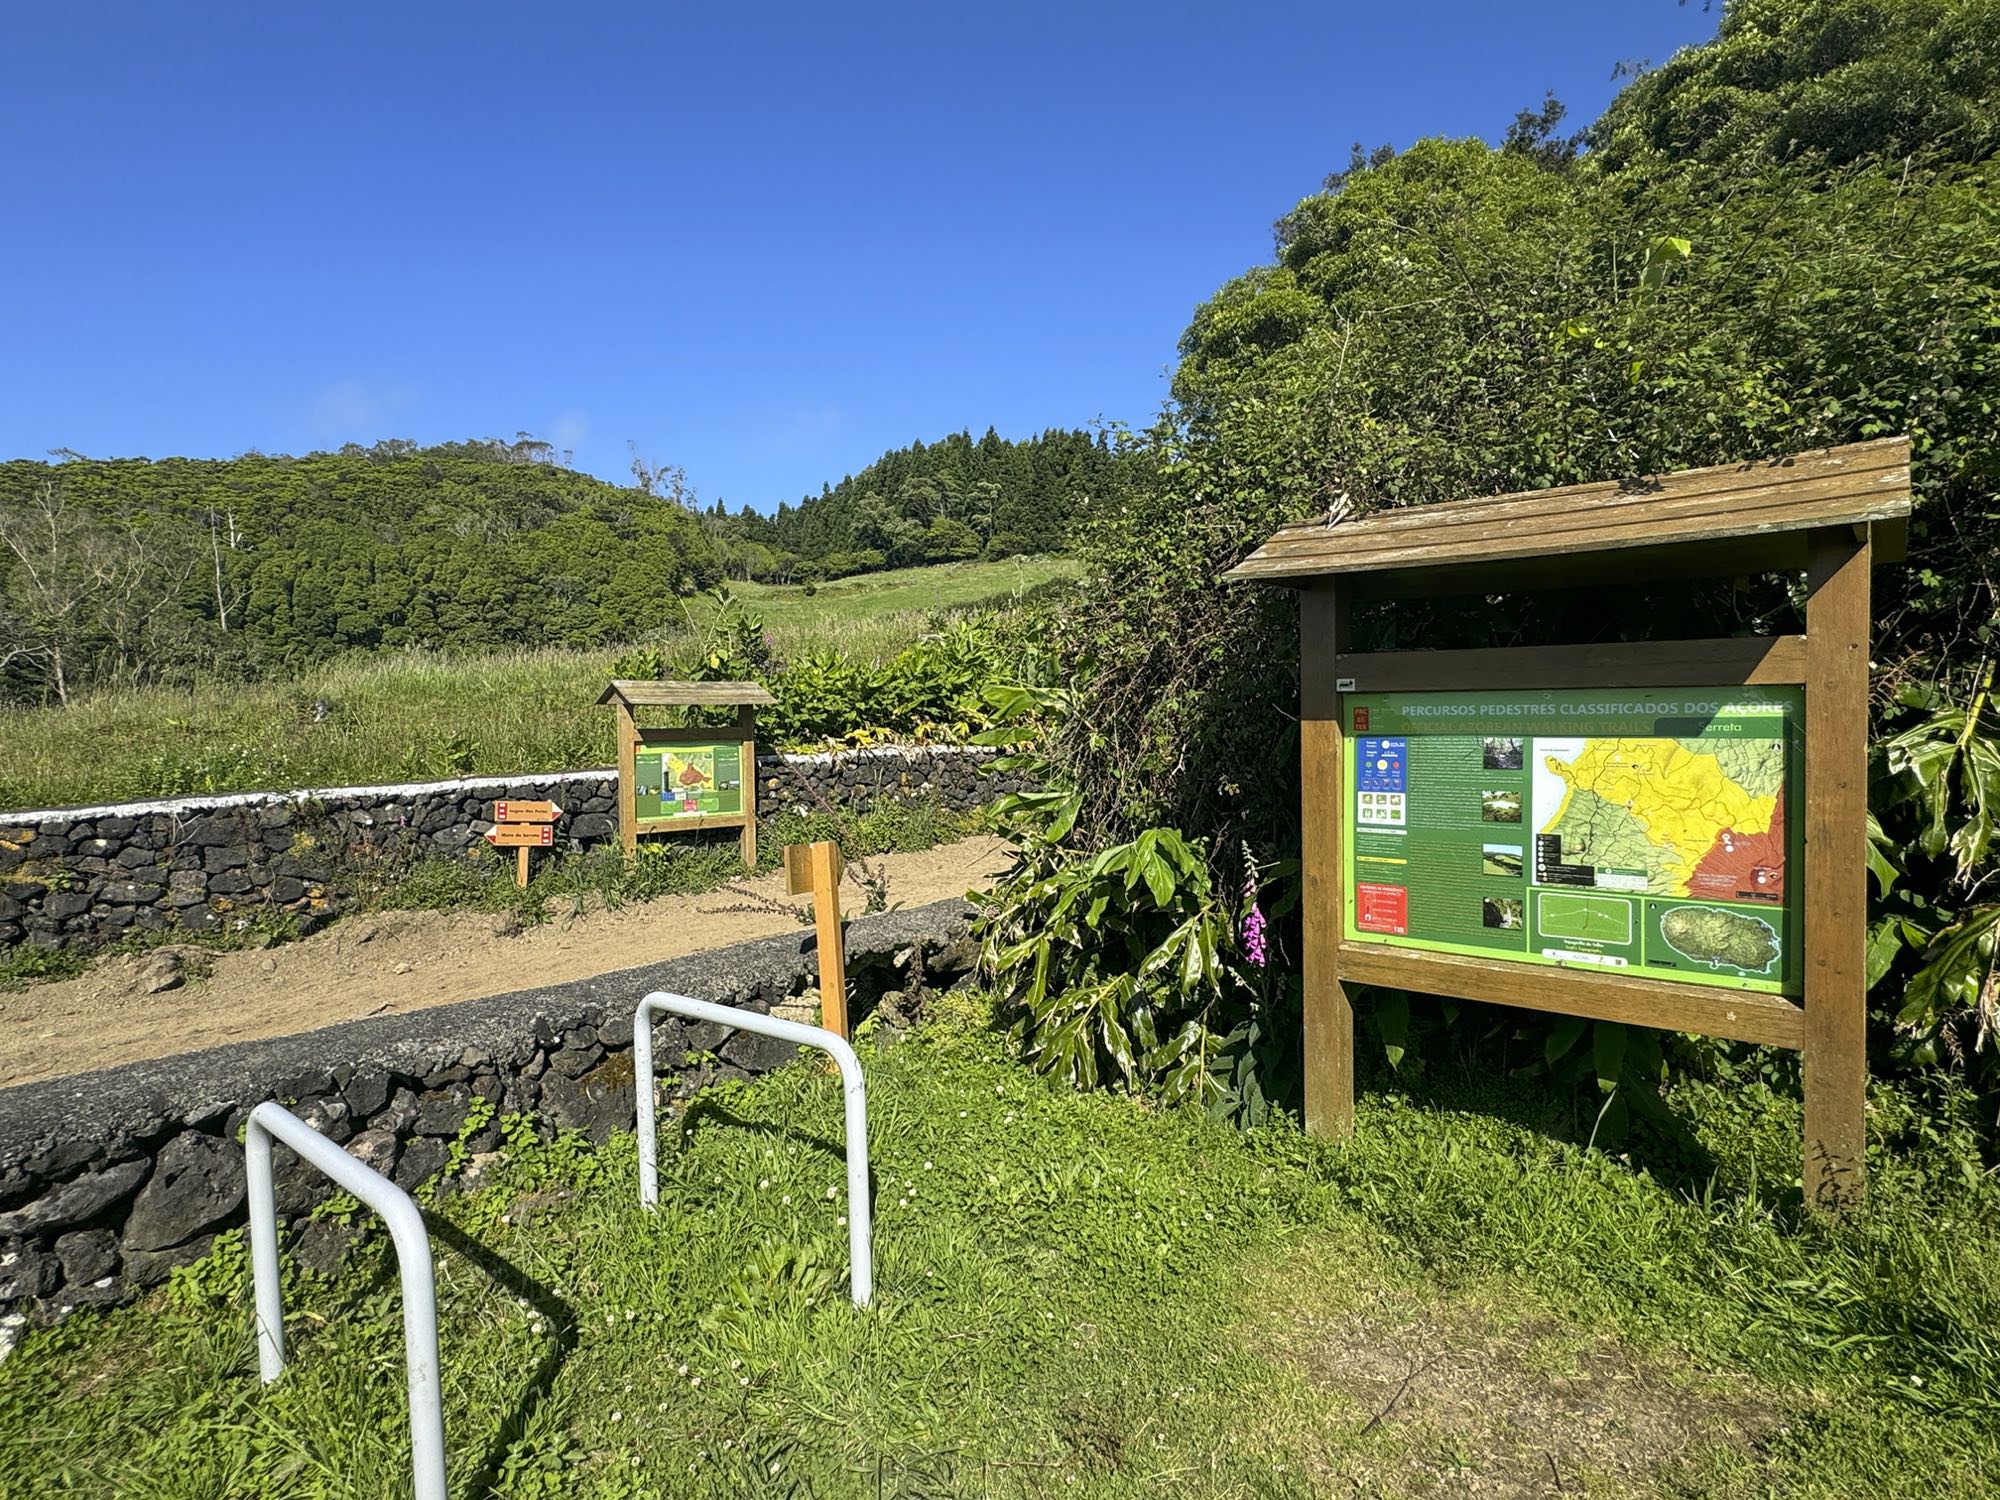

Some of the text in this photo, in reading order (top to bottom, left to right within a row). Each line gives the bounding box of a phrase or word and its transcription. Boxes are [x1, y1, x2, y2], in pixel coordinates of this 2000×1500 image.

[1402, 700, 1793, 716] PERCURSOS PEDESTRES CLASSIFICADOS DOS AÇORES
[1401, 721, 1650, 732] OFFICIAL AZOREAN WALKING TRAILS
[1699, 722, 1742, 732] Serreta
